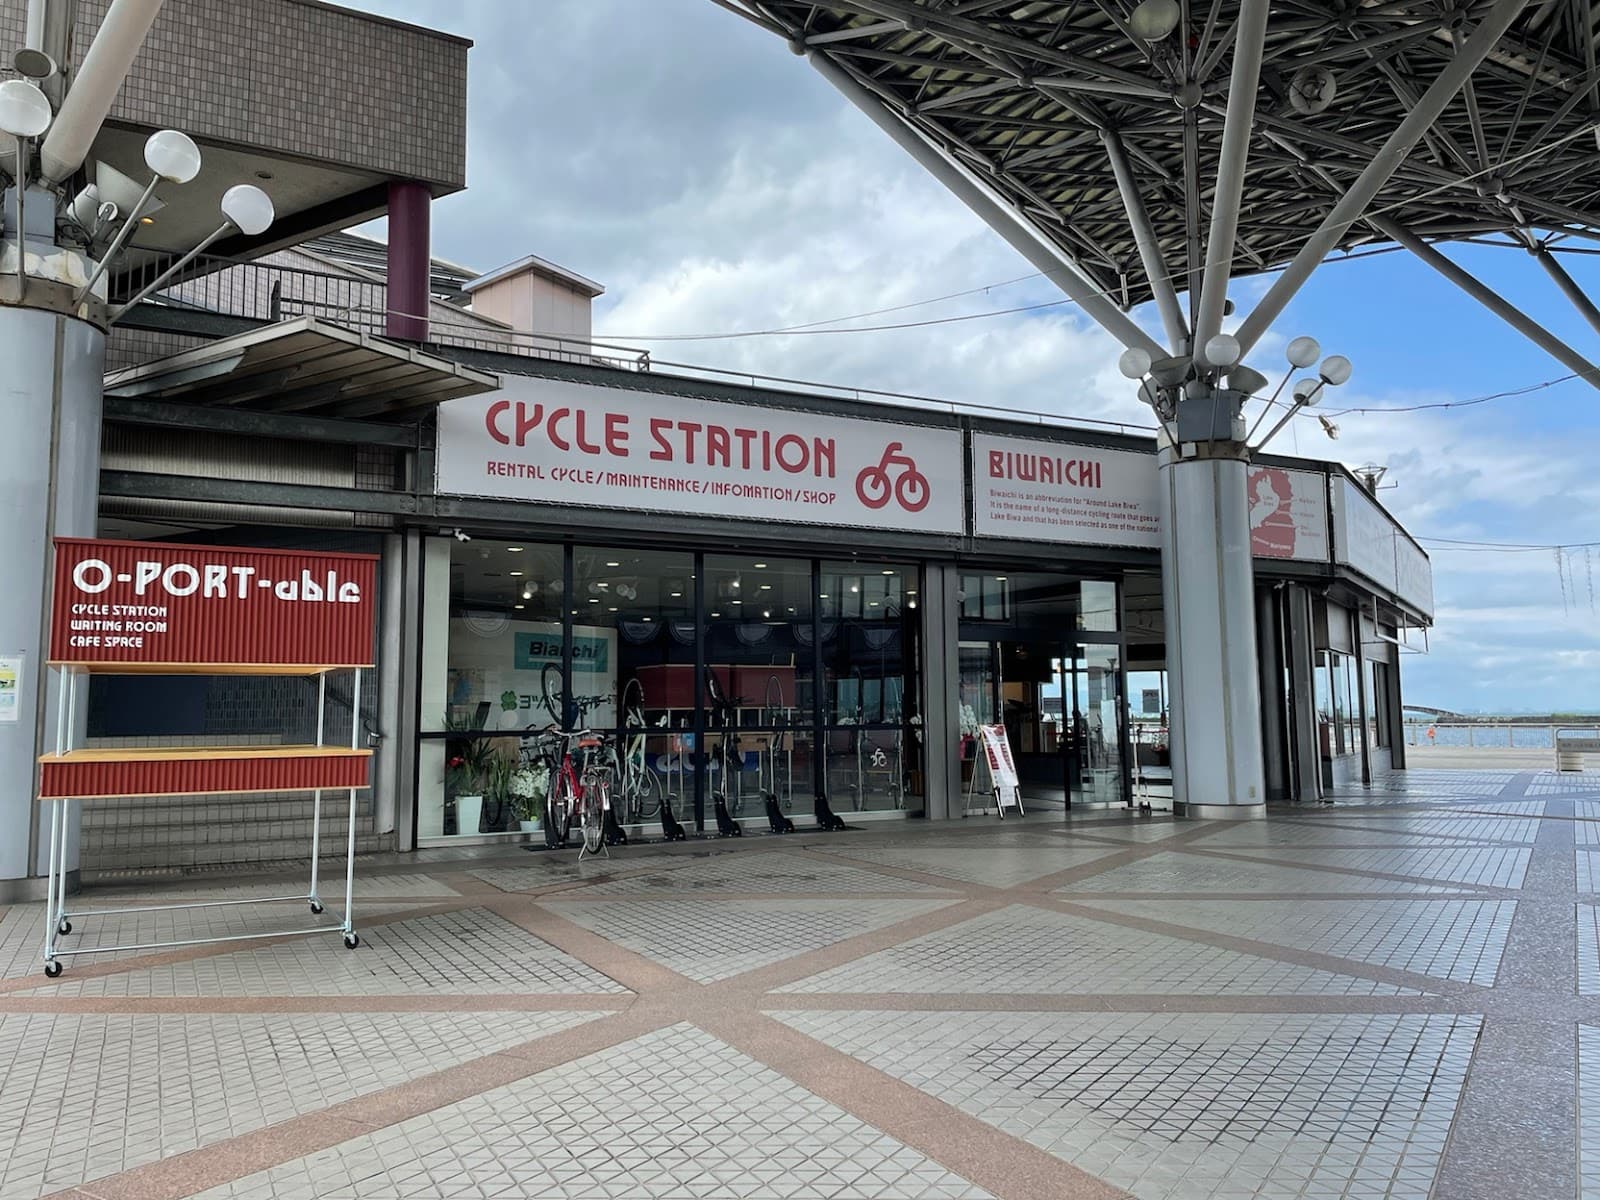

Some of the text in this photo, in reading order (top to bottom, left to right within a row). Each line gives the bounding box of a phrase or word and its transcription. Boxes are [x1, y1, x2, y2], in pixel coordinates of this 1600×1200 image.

[486, 400, 836, 478] CYCLE STATION
[487, 461, 545, 479] RENTAL
[989, 450, 1102, 489] BIWAICHI
[990, 489, 1017, 498] Biwaichi
[1018, 491, 1024, 499] is
[1035, 494, 1072, 504] abbreviation
[1073, 496, 1081, 505] for
[1108, 500, 1122, 509] Lake
[990, 500, 995, 508] It
[1003, 502, 1013, 510] the
[1046, 506, 1087, 516] long-distance
[1088, 510, 1110, 519] cycling
[1111, 512, 1126, 520] route
[990, 512, 1005, 520] Lake
[1006, 513, 1021, 521] Biwa
[1035, 516, 1046, 524] that
[1047, 516, 1058, 525] has
[1059, 518, 1074, 526] been
[1075, 520, 1099, 528] selected
[1136, 525, 1159, 533] national
[72, 559, 361, 603] O-PORT-able
[72, 603, 167, 617] CYCLE STATION
[70, 619, 167, 632] WAITING ROOM
[70, 635, 143, 648] CAFE SPACE
[529, 641, 599, 658] Biachi
